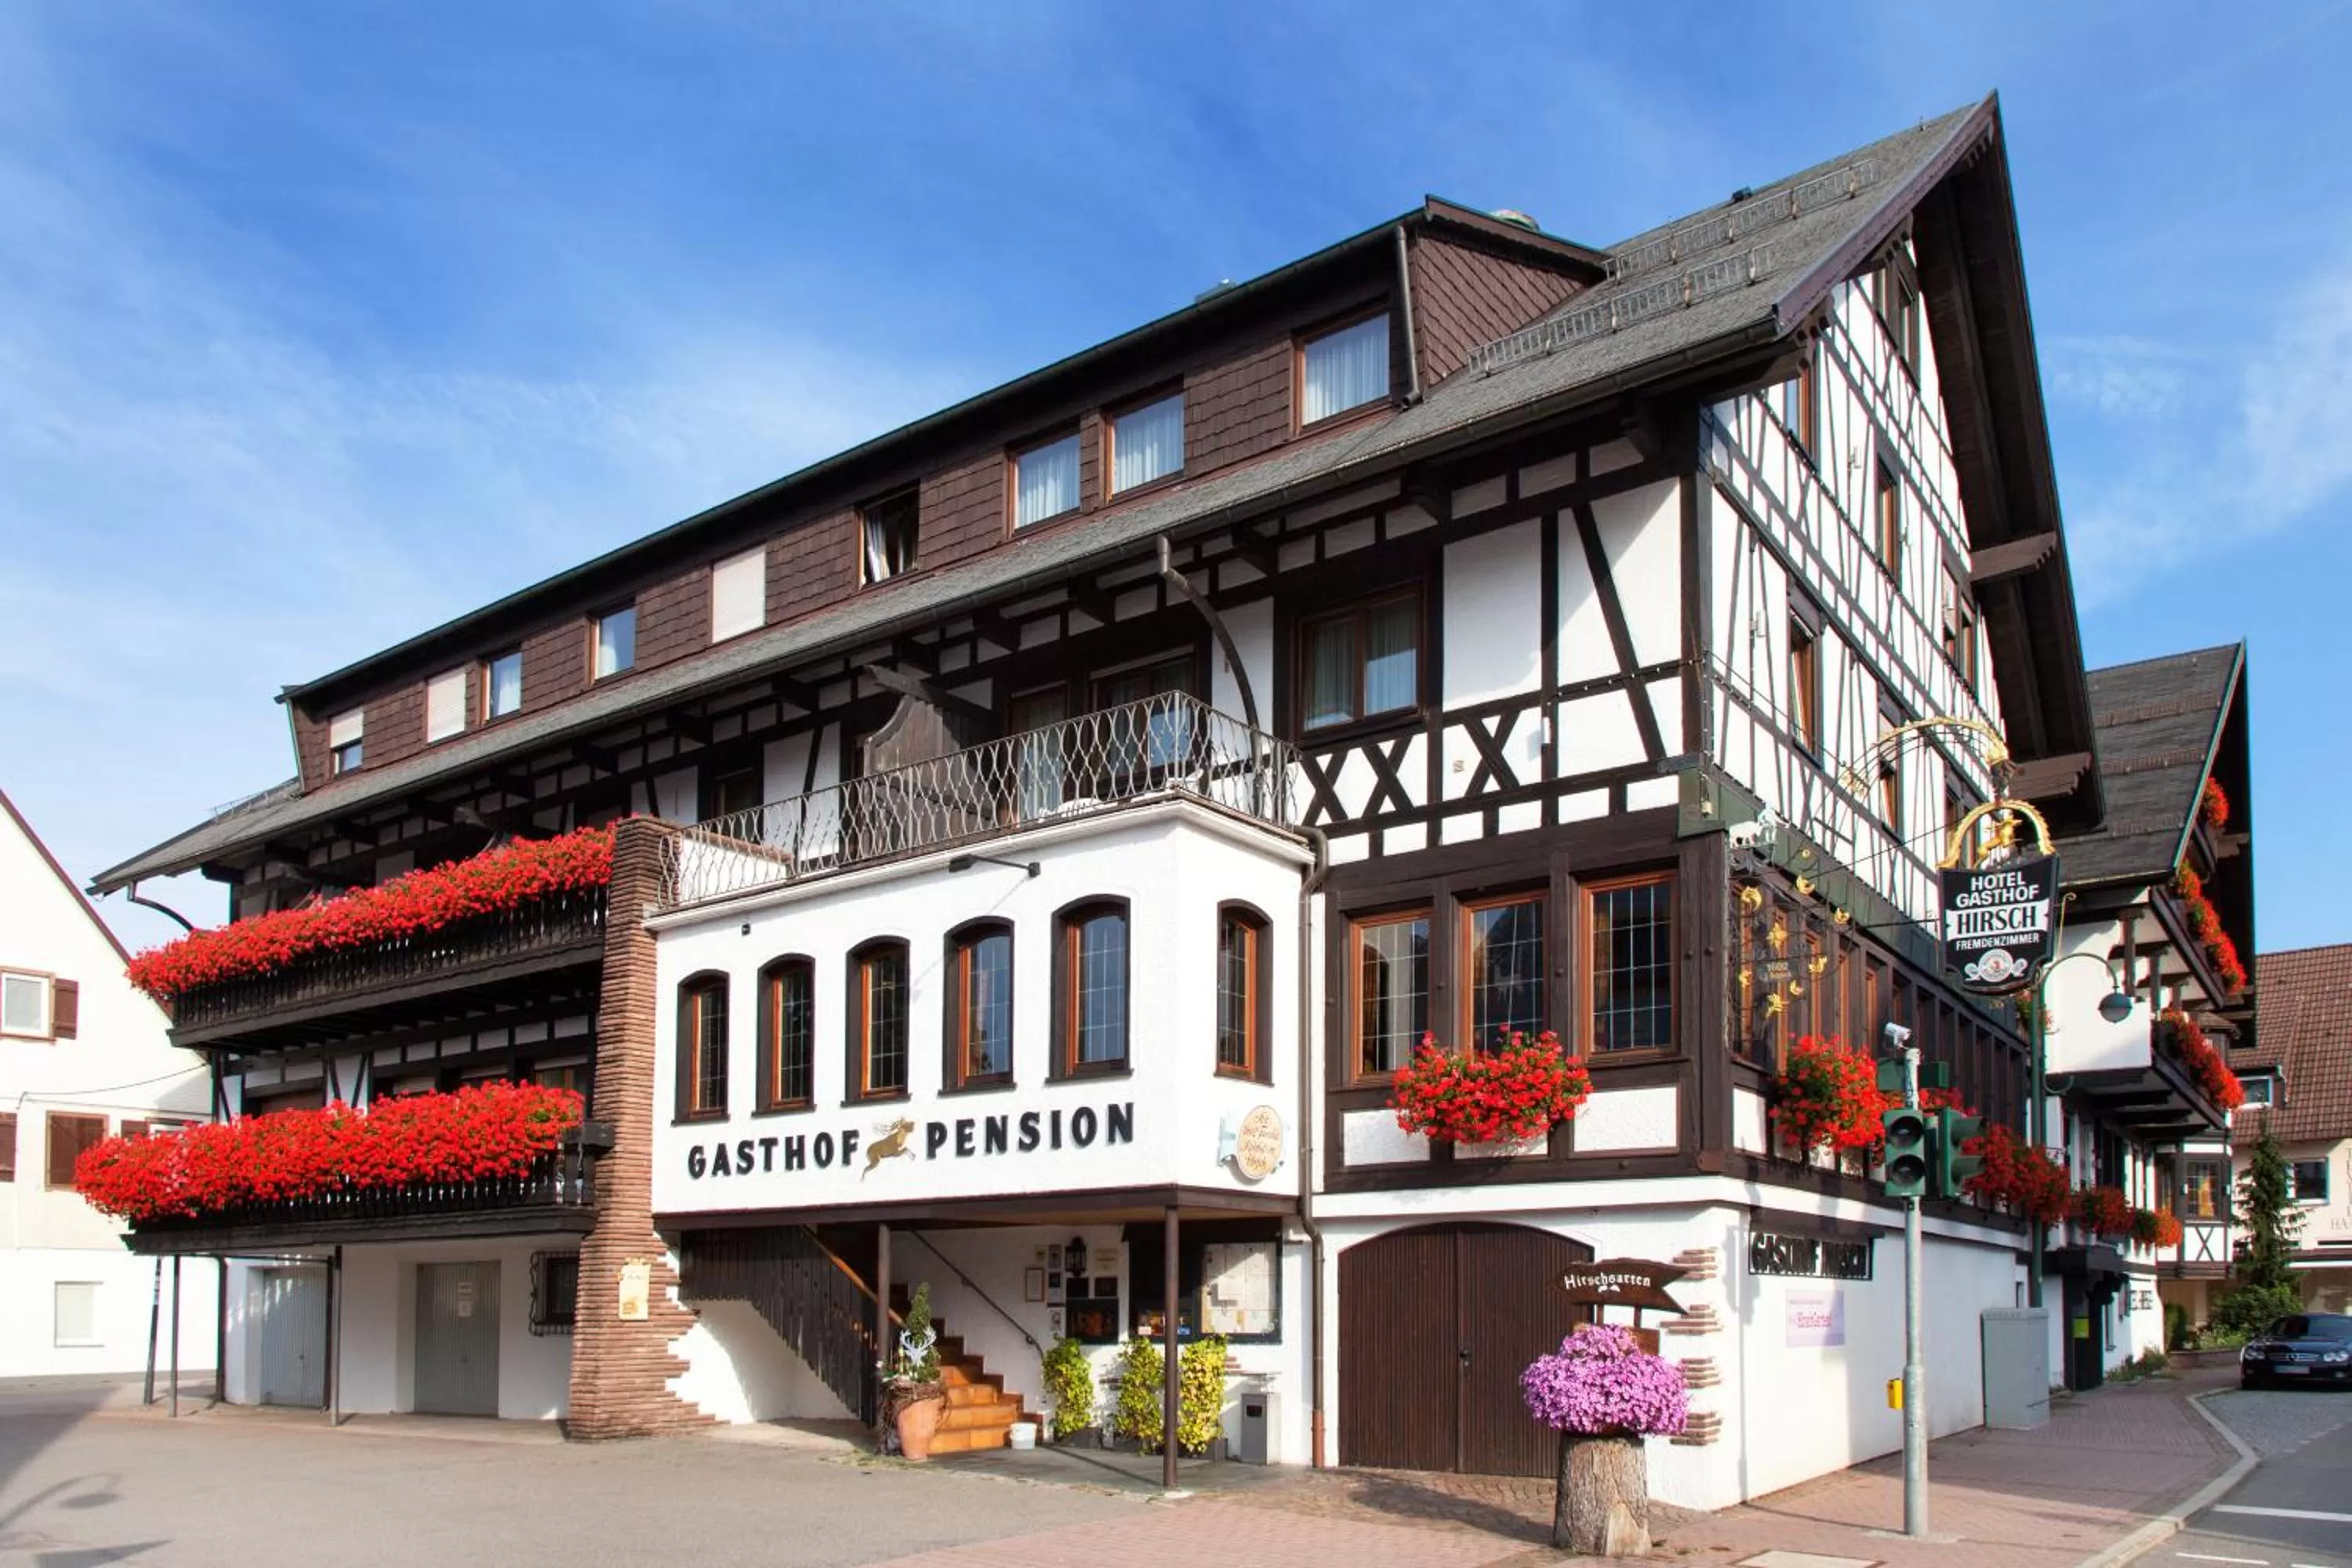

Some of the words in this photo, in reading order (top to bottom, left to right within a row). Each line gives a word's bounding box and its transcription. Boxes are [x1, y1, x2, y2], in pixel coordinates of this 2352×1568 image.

[1971, 872, 2026, 891] HOTEL
[1956, 885, 2039, 907] GASTHOF
[1957, 907, 2036, 934] HIRSCH
[1956, 934, 2039, 950] FREMDENZIMMER
[688, 1129, 860, 1179] GASTHOF
[926, 1102, 1134, 1160] PENSION
[1564, 1272, 1650, 1290] Hirschgarten
